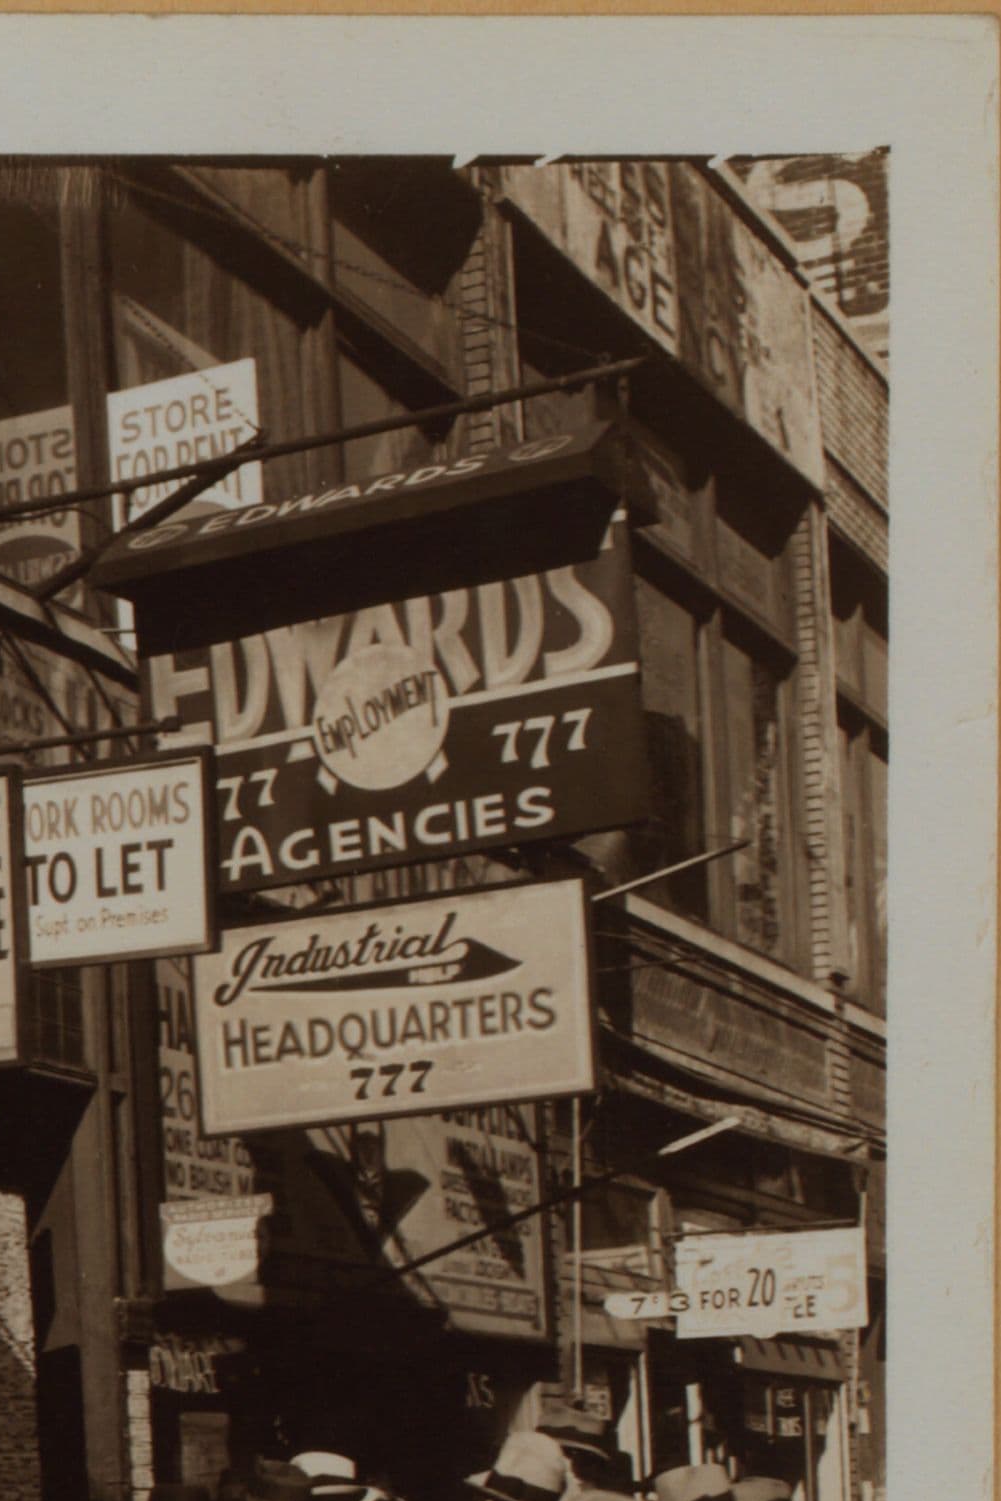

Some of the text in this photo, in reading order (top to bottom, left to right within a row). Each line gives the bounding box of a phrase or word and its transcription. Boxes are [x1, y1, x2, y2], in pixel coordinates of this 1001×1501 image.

[121, 387, 234, 444] STORE
[195, 454, 490, 535] EDWARDS
[148, 564, 616, 752] EDWARDS
[492, 708, 593, 769] 777
[91, 781, 191, 835] ROOMS
[220, 787, 556, 882] AGENCIES
[25, 838, 174, 906] TO LET
[213, 911, 463, 1007] Industrial
[222, 987, 557, 1069] HEADQUARTERS
[350, 1060, 434, 1099] 777
[668, 1292, 690, 1313] 3
[700, 1288, 742, 1311] FOR
[747, 1267, 777, 1307] 20
